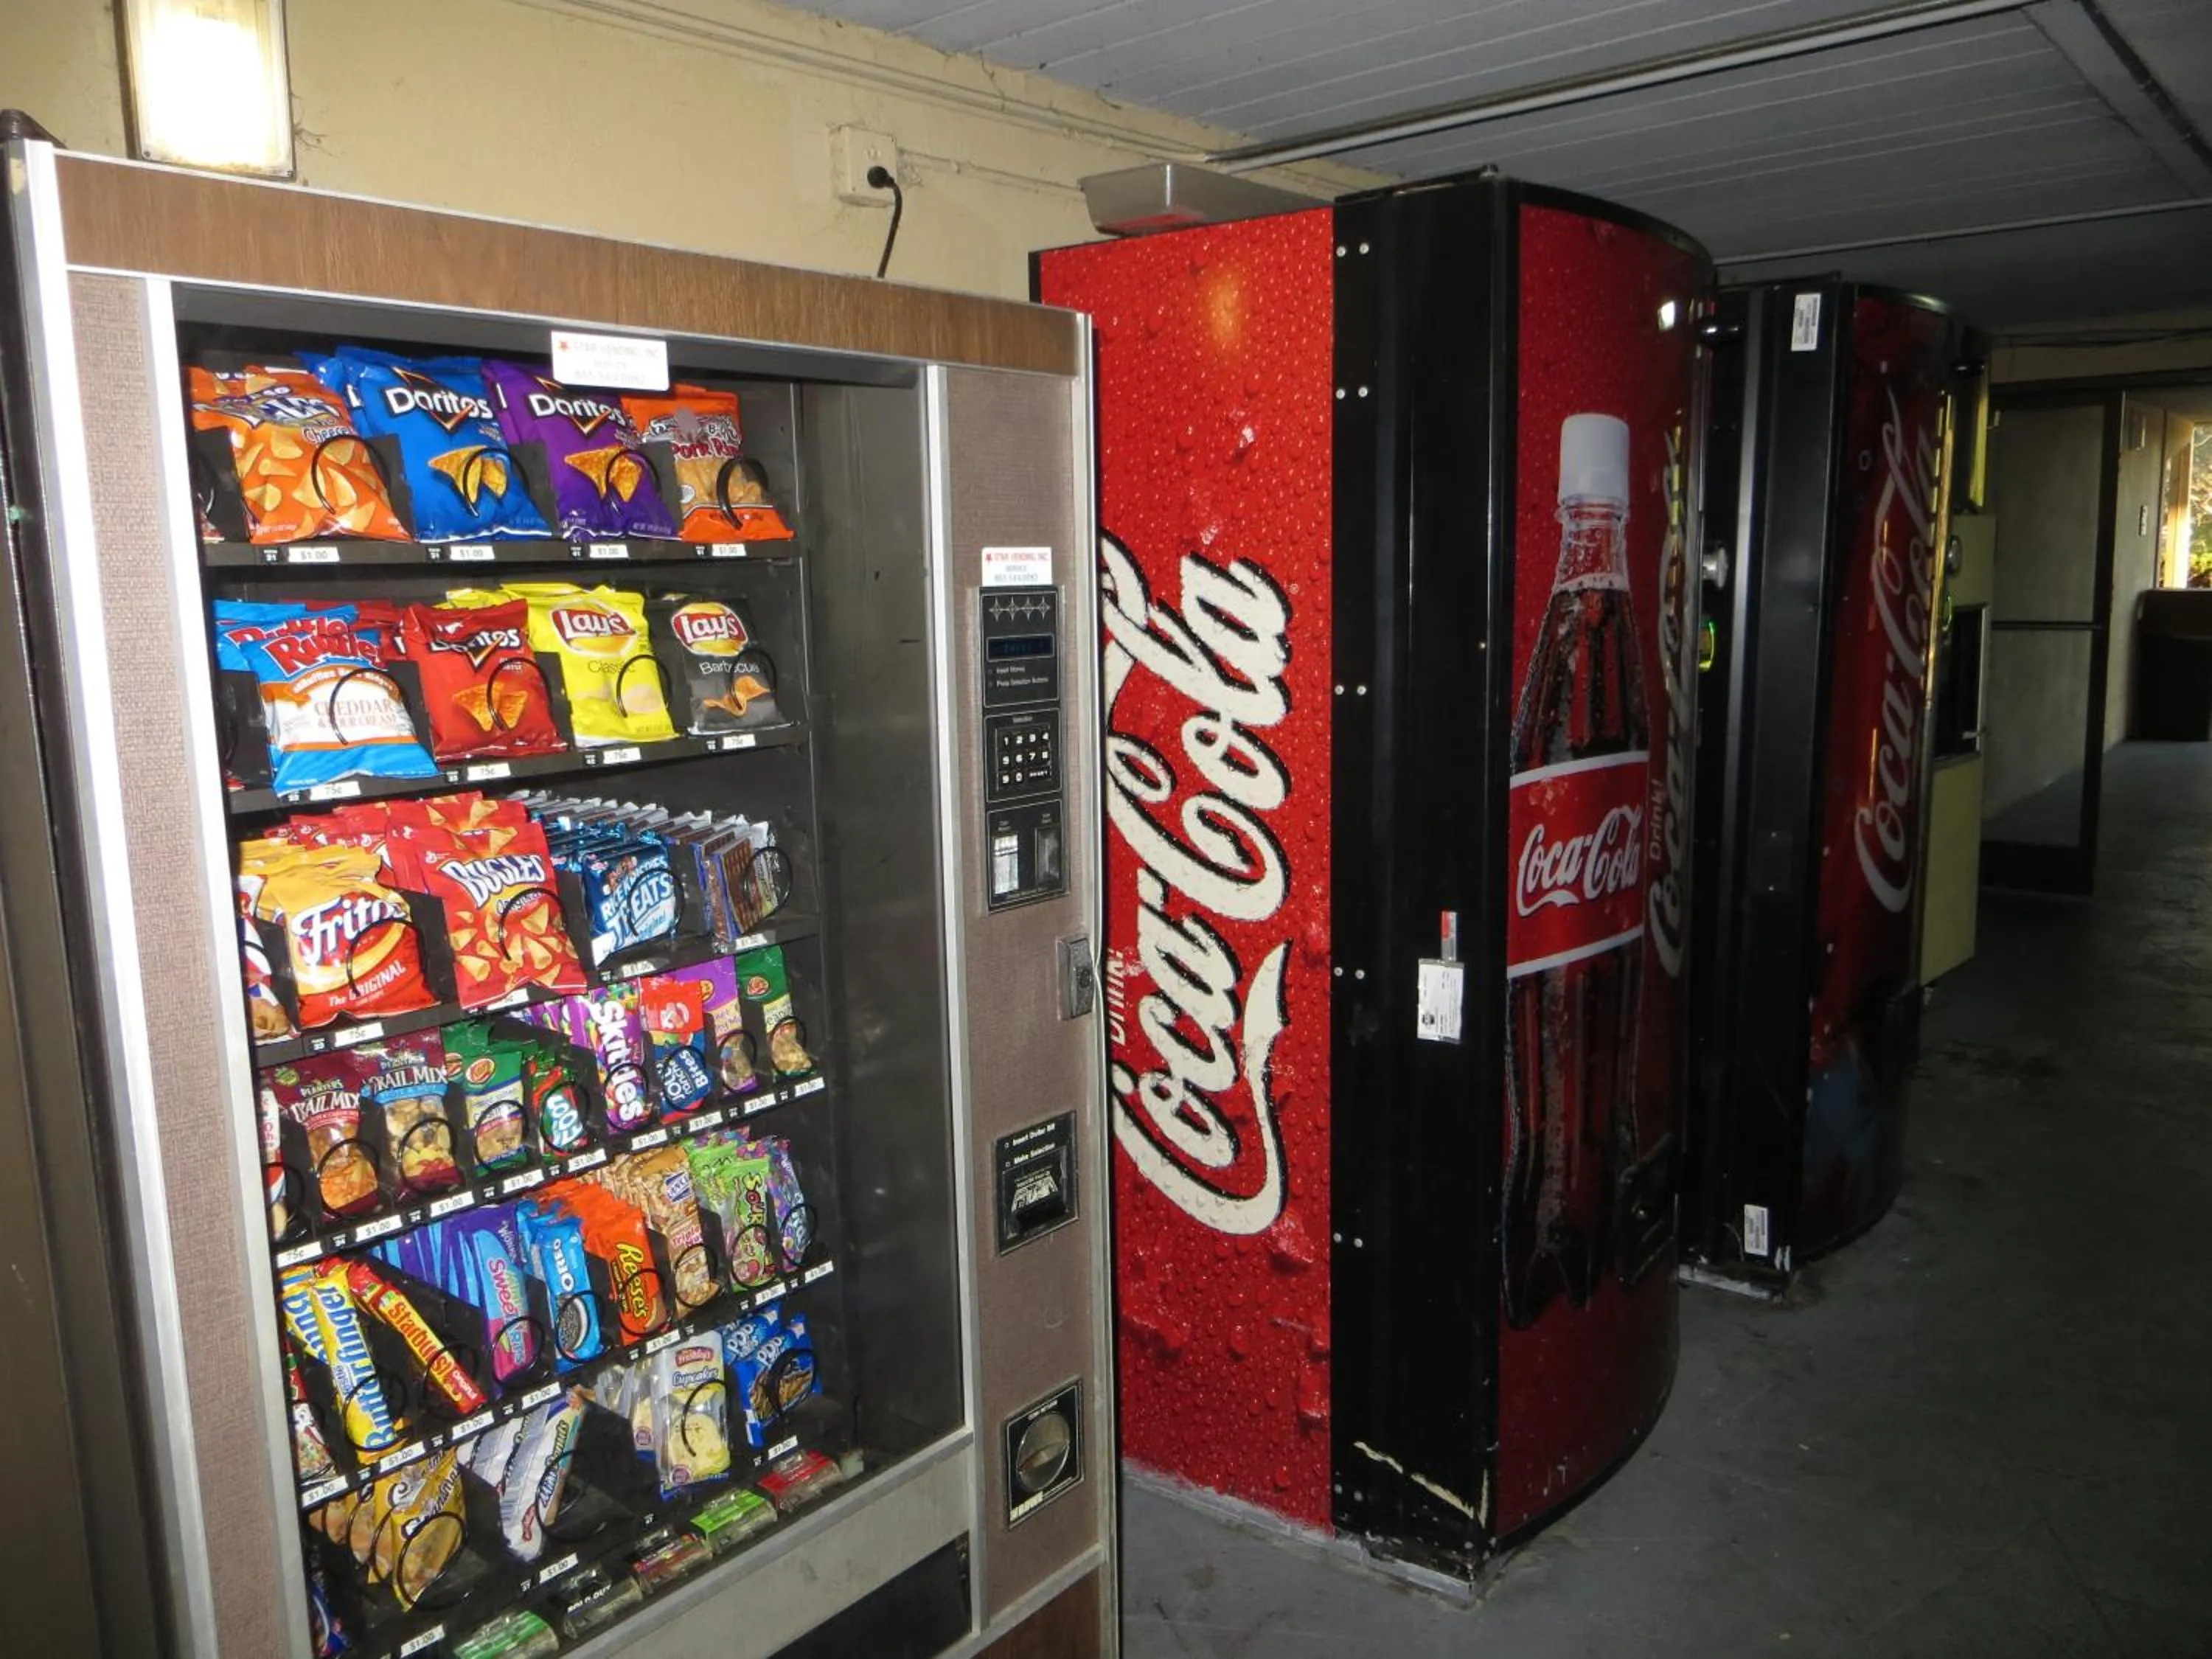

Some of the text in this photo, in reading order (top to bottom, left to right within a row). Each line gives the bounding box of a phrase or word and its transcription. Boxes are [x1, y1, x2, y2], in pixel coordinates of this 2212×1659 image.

[385, 386, 493, 420] Doritos
[529, 394, 625, 426] Doritos
[588, 660, 636, 674] Classc
[1649, 779, 1668, 861] Drink!
[1517, 804, 1641, 917] Coca-Cola
[442, 853, 547, 908] BUGLES
[413, 1065, 448, 1085] MIX
[595, 1001, 644, 1121] Skittles
[438, 1196, 464, 1211] $1.00
[364, 1220, 391, 1237] $1.00
[615, 1242, 648, 1318] Reese's
[388, 1300, 454, 1380] Starburst
[529, 1387, 552, 1402] $1.00
[459, 1416, 485, 1432] $1.00
[307, 1482, 335, 1500] $1.00
